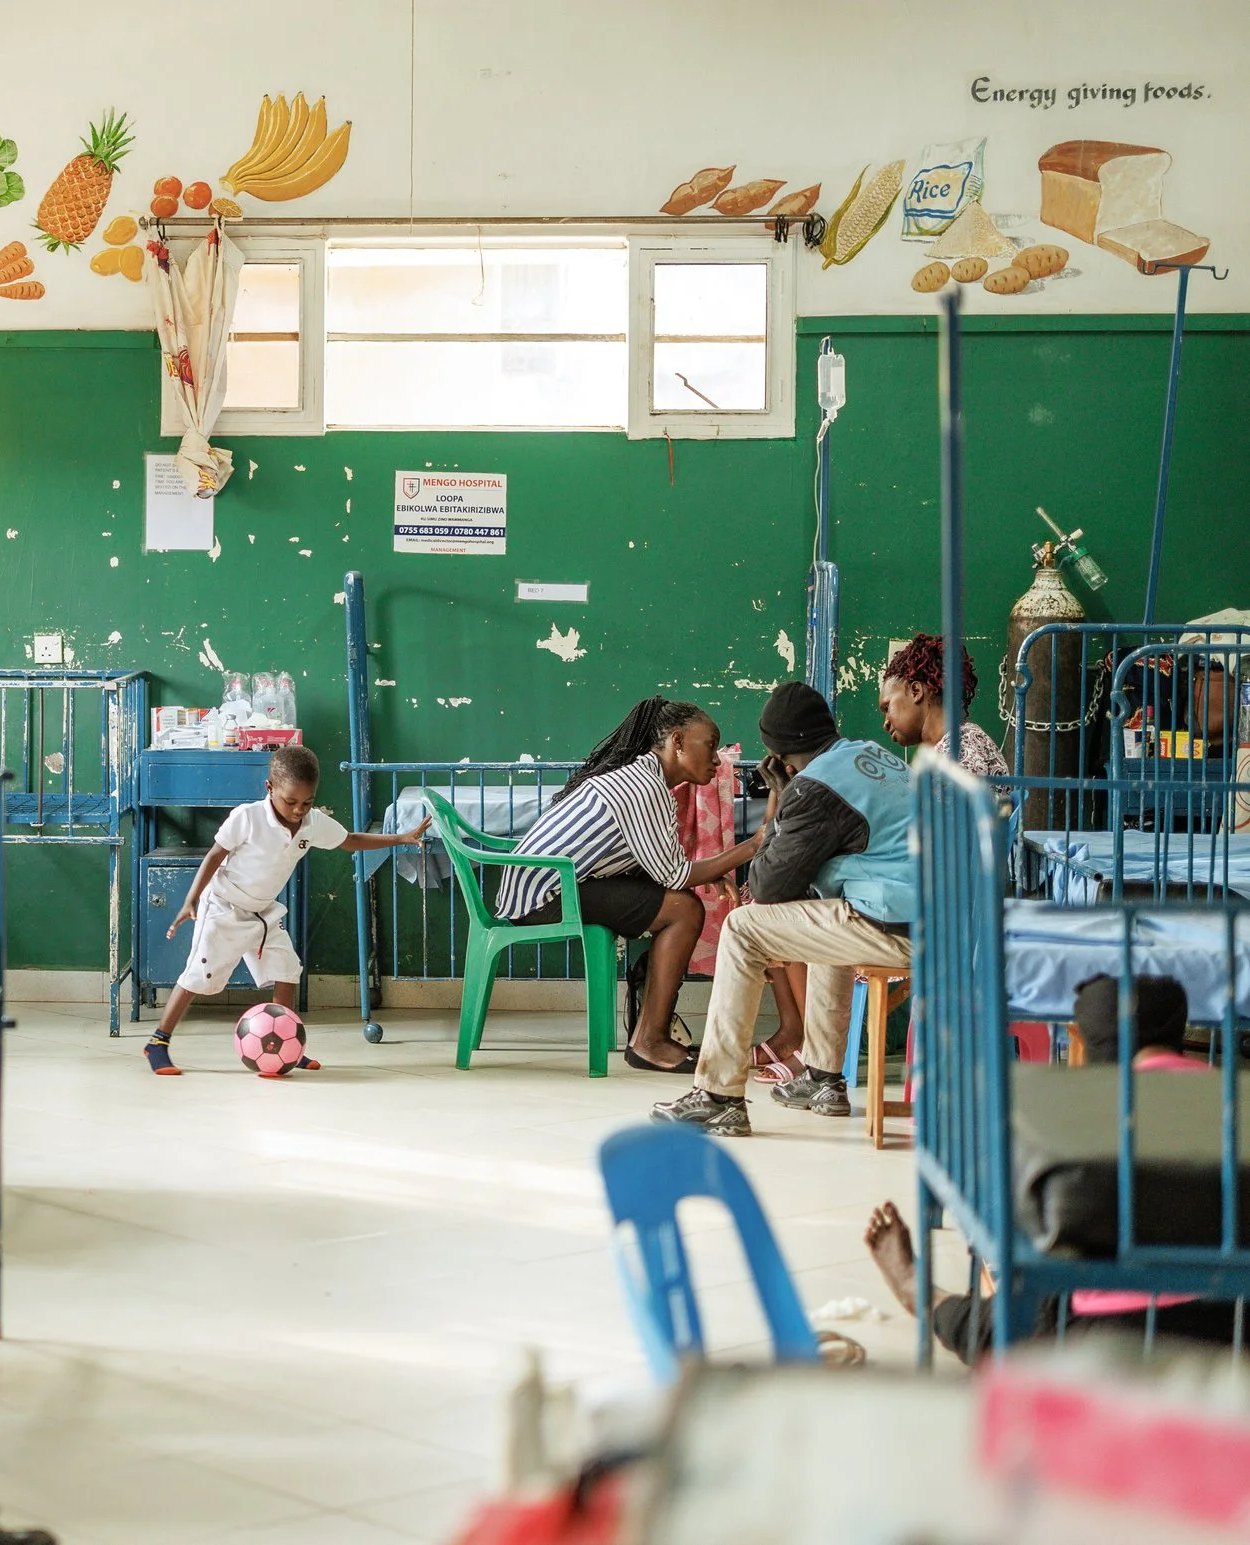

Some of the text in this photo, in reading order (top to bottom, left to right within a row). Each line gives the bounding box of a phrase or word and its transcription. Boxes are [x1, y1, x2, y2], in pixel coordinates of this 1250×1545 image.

[970, 76, 1212, 109] Energy giving foods.
[907, 179, 951, 203] Rice
[423, 478, 502, 488] MENGO HOSPITAL
[436, 495, 464, 503] LOOPA
[396, 504, 505, 514] EBIKOLWA EBITAKIRIZIBWA
[399, 526, 418, 534] 0755
[434, 527, 449, 535] 059
[490, 528, 504, 536] 861
